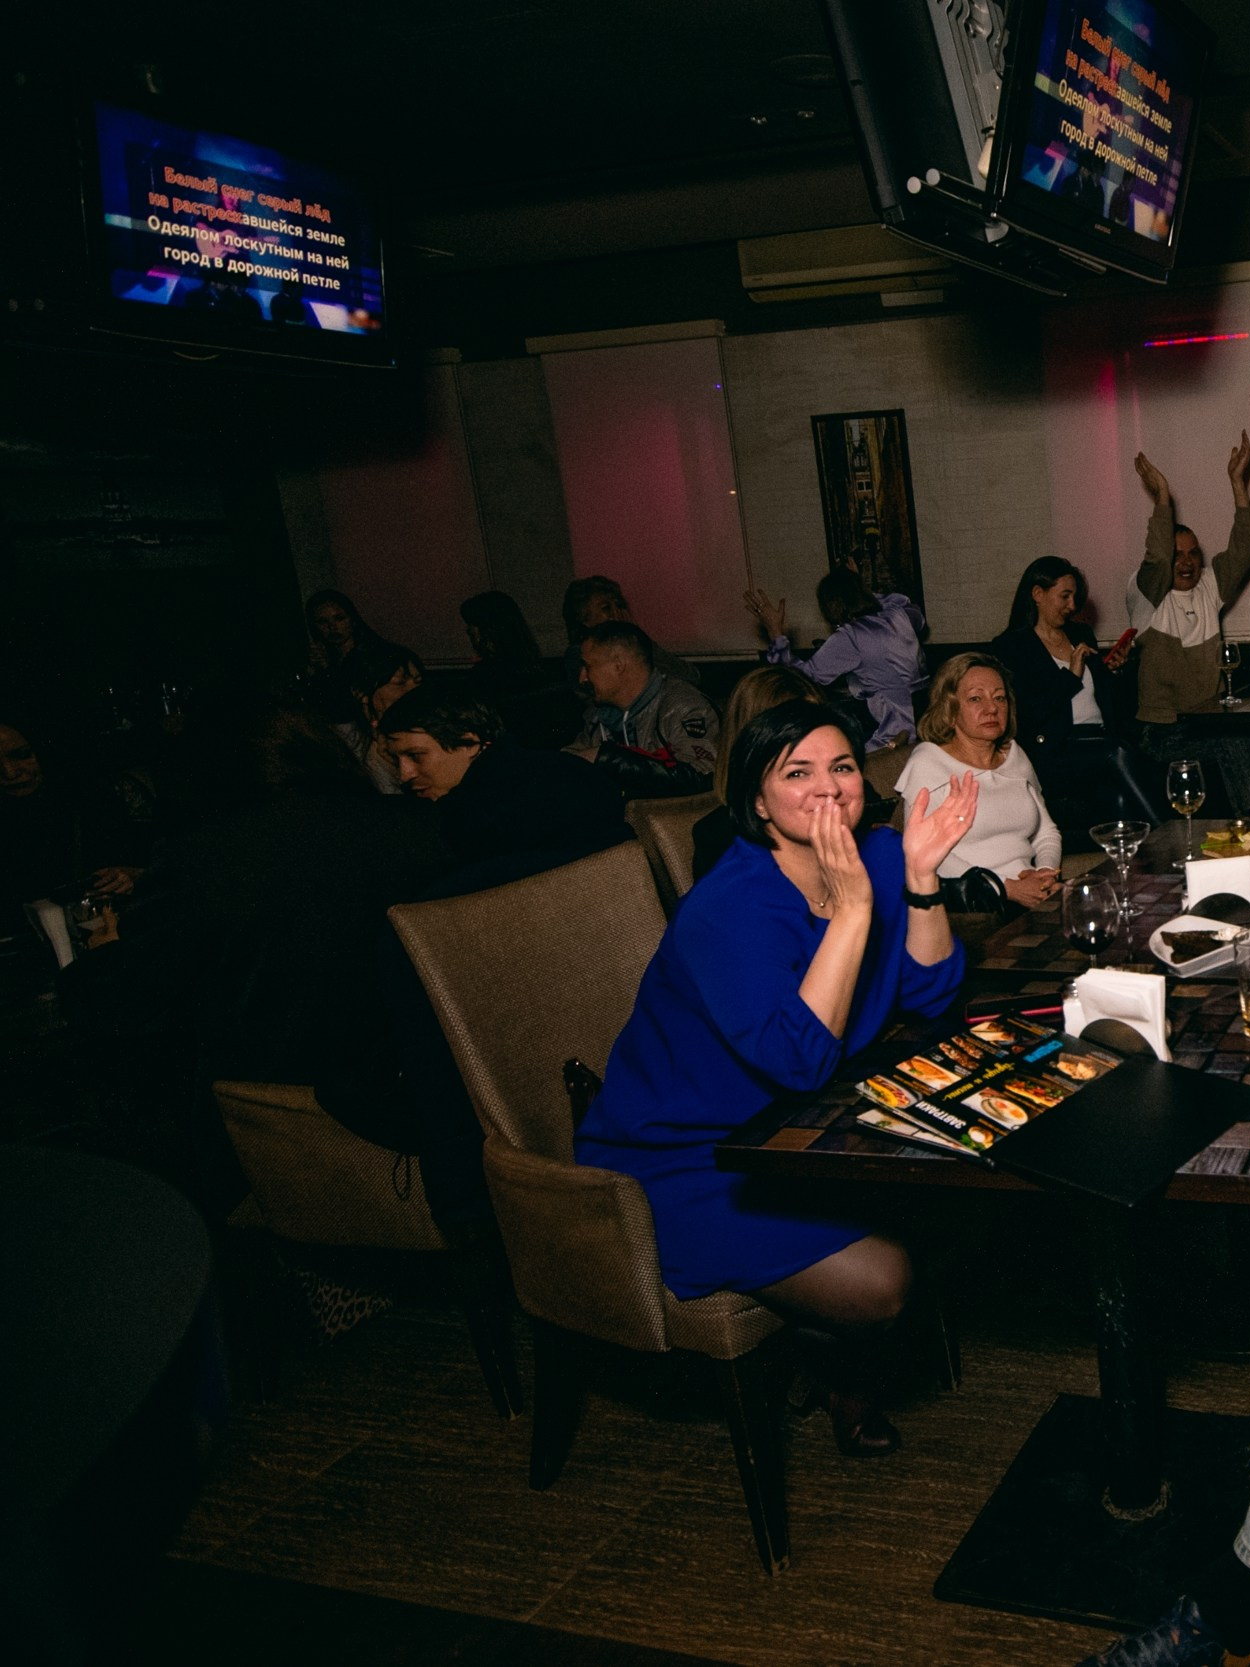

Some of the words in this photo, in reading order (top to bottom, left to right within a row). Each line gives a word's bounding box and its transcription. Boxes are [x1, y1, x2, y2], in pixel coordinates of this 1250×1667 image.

[1080, 17, 1113, 57] Белый
[1112, 46, 1133, 71] снег
[1131, 61, 1157, 91] серый
[1065, 49, 1079, 71] на
[1078, 58, 1150, 119] растрескавшейся
[1150, 109, 1173, 134] земле
[1059, 79, 1100, 118] Одеялом
[1100, 109, 1145, 147] лоскутным
[1144, 137, 1155, 154] на
[1154, 145, 1169, 162] ней
[1061, 119, 1087, 149] город
[1088, 137, 1095, 150] в
[1095, 141, 1137, 173] дорожной
[1136, 164, 1158, 186] петле
[148, 192, 169, 209] на
[172, 197, 303, 237] растрескавшейся
[306, 228, 346, 247] земле
[163, 166, 218, 194] Белый
[220, 184, 255, 203] снег
[257, 193, 303, 214] серый
[305, 203, 332, 223] лёд
[147, 214, 220, 243] Одеялом
[223, 235, 304, 261] лоскутным
[307, 251, 323, 264] на
[326, 255, 350, 270] ней
[163, 246, 211, 268] город
[214, 257, 224, 268] в
[227, 259, 299, 283] дорожной
[302, 273, 341, 290] петле
[915, 1100, 967, 1130] ЗАВТРАКИ
